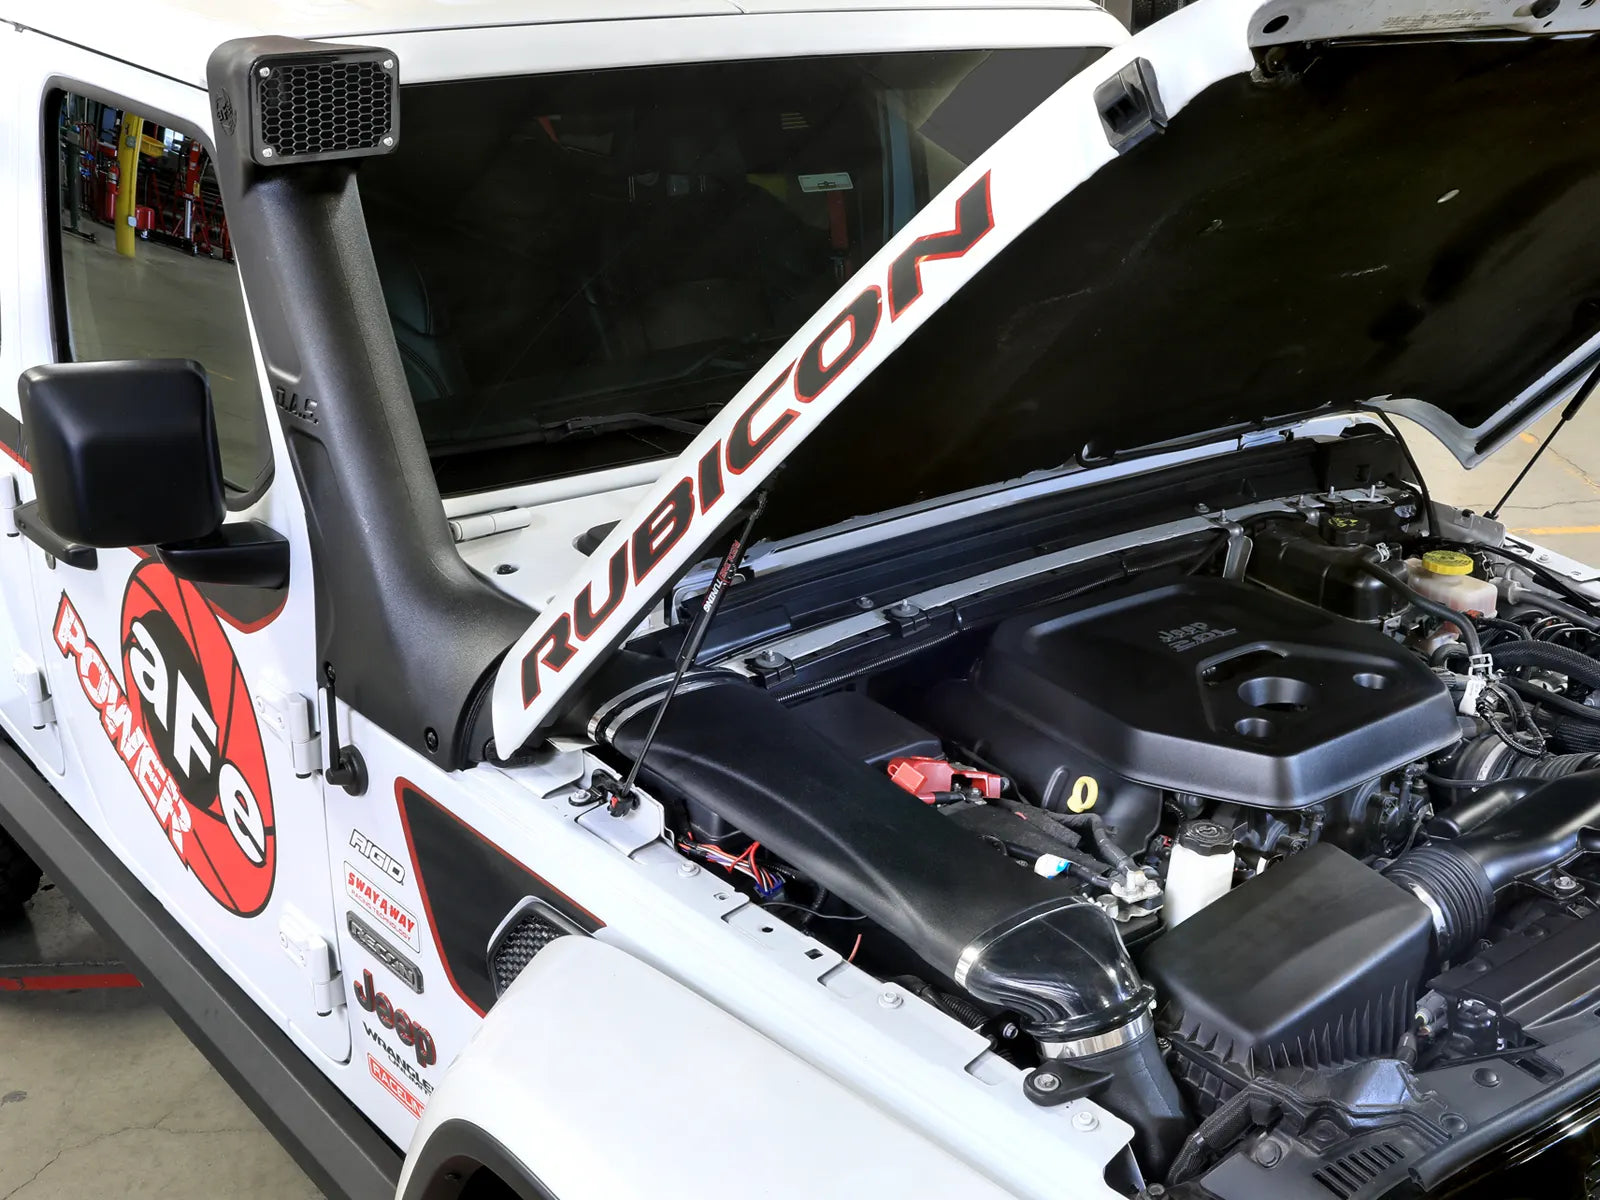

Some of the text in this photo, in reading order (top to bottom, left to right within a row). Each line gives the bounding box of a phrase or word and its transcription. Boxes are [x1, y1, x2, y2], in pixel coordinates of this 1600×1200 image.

[522, 168, 996, 710] RUBICON
[703, 578, 723, 613] TUNING
[53, 589, 191, 870] POWER
[129, 620, 268, 867] aFe
[349, 828, 406, 886] RIGID
[354, 968, 437, 1068] Jeep
[362, 1020, 435, 1092] WRANGLE
[372, 1062, 425, 1118] RACELIN
